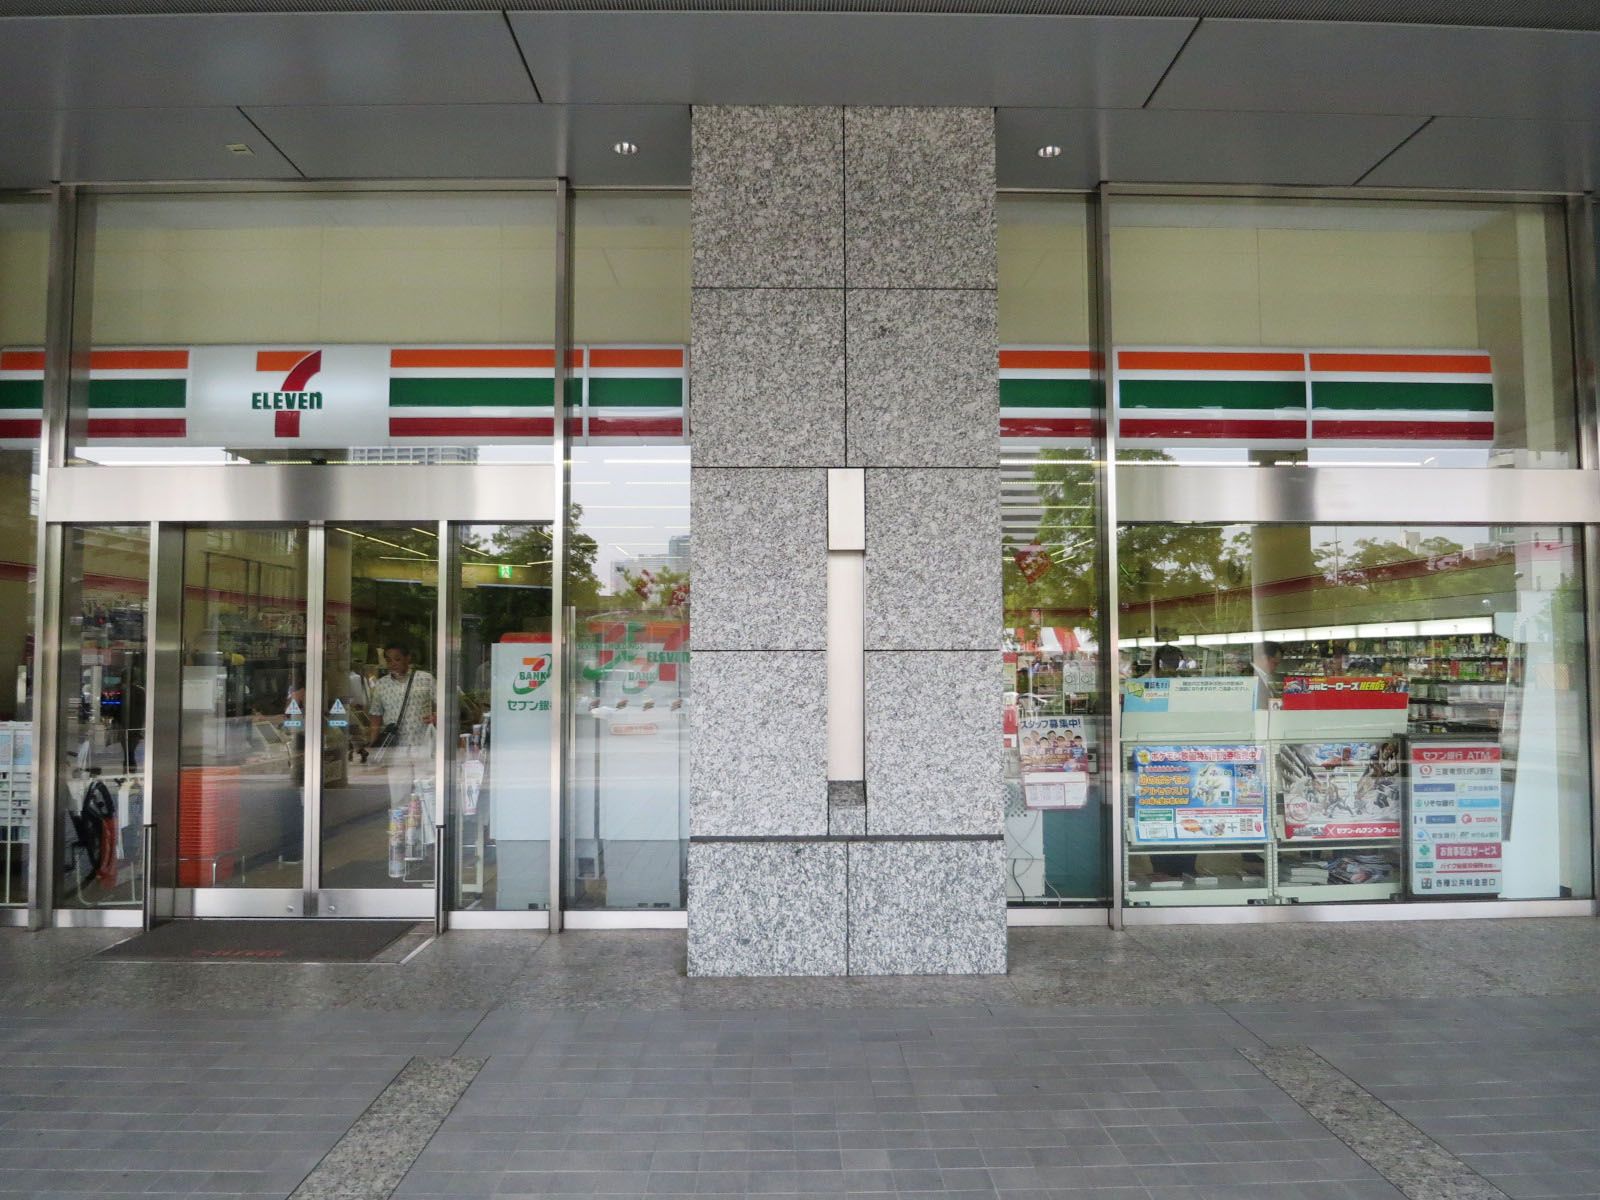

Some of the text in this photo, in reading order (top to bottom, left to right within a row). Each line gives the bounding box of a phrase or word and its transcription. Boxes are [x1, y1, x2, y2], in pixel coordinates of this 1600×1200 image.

[256, 350, 322, 437] 7
[519, 672, 547, 680] BANK
[1467, 752, 1491, 760] ATM
